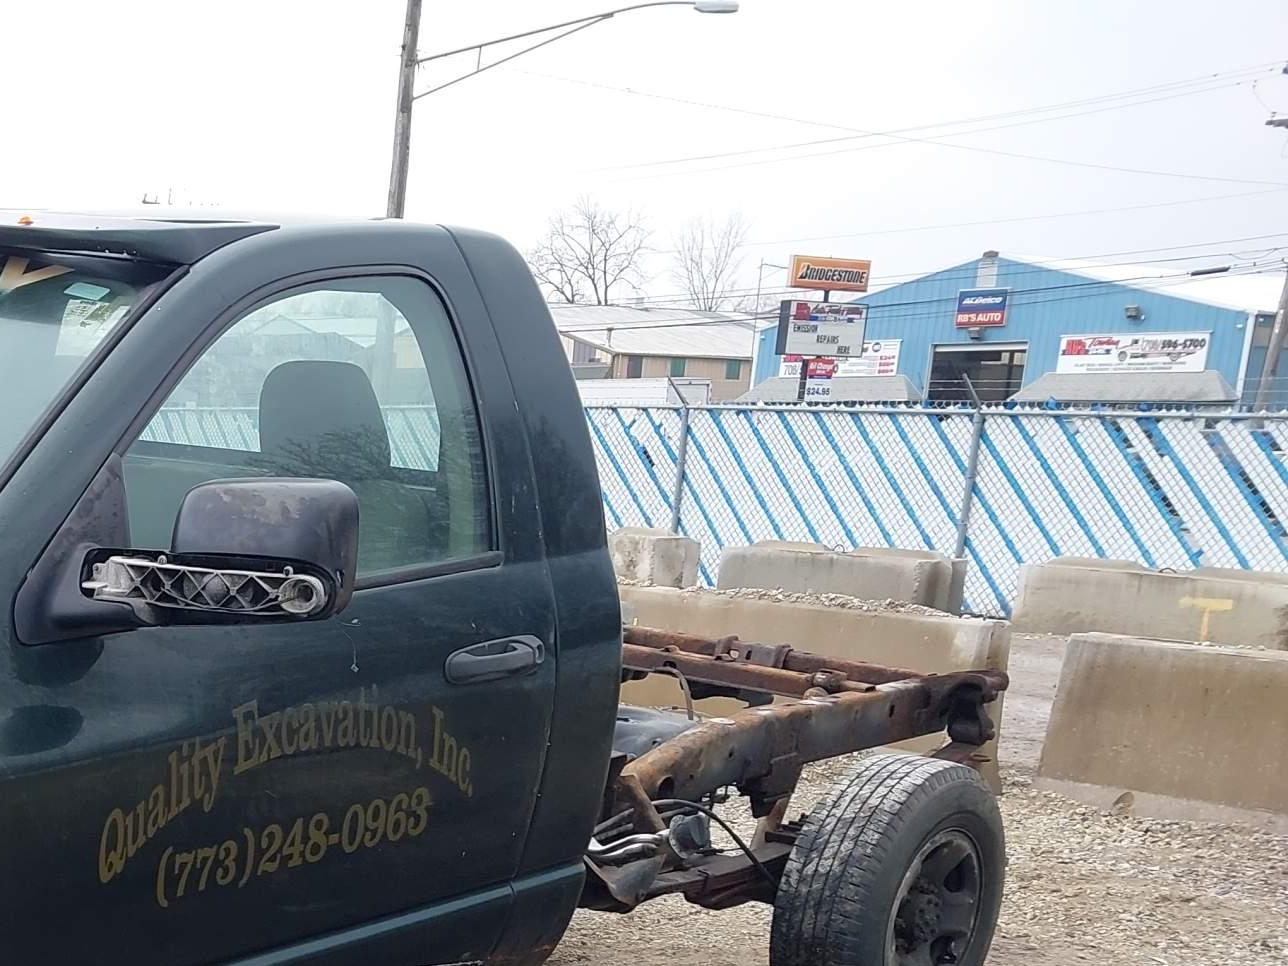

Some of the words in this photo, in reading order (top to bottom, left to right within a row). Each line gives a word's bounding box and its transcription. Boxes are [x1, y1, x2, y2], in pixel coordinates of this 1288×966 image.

[798, 263, 867, 284] BRIDGESTONE
[976, 312, 1002, 322] AUTO
[816, 335, 839, 344] REPAIRS
[836, 346, 851, 354] HERE
[98, 733, 227, 883] Quality
[232, 683, 423, 775] Excavation,
[156, 787, 432, 909] (773)248-0963
